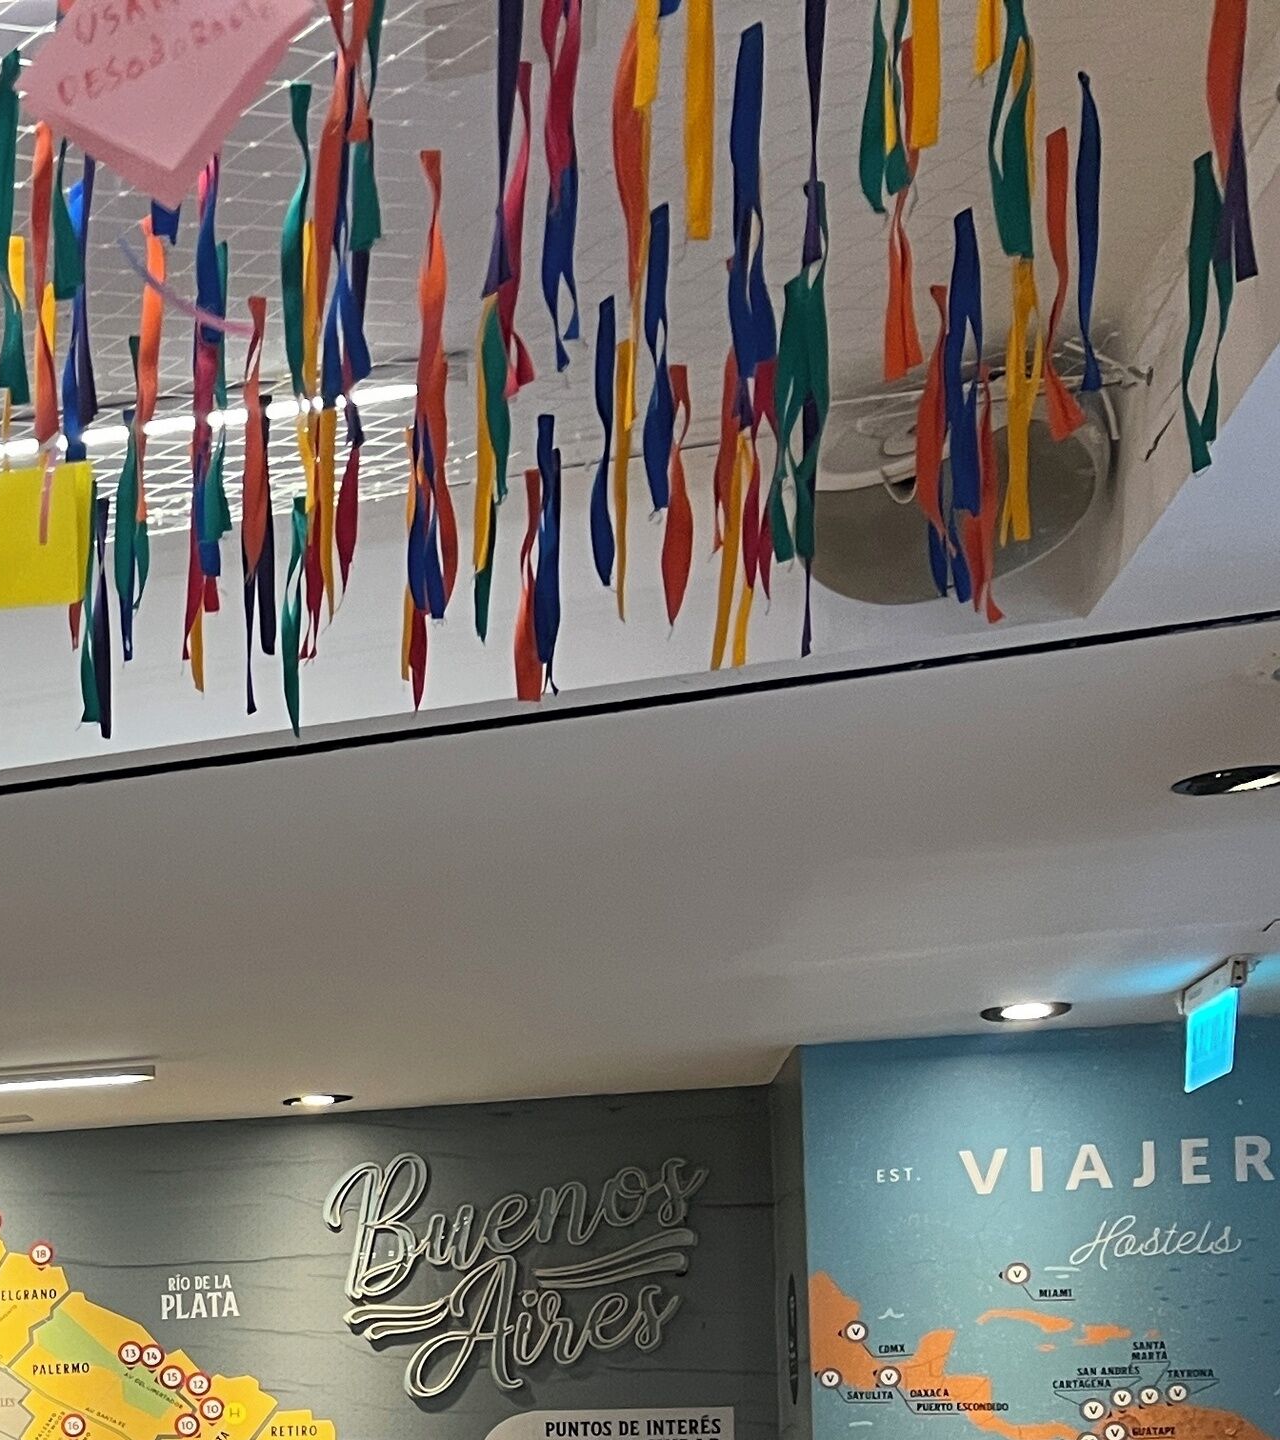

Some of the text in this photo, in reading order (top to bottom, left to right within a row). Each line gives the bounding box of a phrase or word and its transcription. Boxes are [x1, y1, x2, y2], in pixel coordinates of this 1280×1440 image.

[876, 1134, 1276, 1195] EST. VIAJER
[322, 1151, 710, 1300] Buenos
[1070, 1214, 1242, 1271] Hostels
[168, 1273, 232, 1291] RÍO DE LA
[1038, 1288, 1073, 1299] MIAMI
[161, 1291, 240, 1321] PLATA
[404, 1254, 680, 1399] Aires
[878, 1343, 905, 1354] CDMX
[1132, 1341, 1166, 1351] SANTA
[1131, 1351, 1168, 1361] MARTA
[32, 1362, 90, 1375] PALERMO
[1077, 1367, 1097, 1376] SAN
[1167, 1368, 1214, 1378] TAYRONA
[1052, 1378, 1111, 1389] CARTAGENA
[846, 1391, 893, 1400] SAYULITA
[909, 1388, 950, 1398] OAXACA
[916, 1402, 1009, 1412] PUERTO ESCONDIDO
[271, 1425, 317, 1437] RETIRO
[546, 1415, 721, 1437] PUNTOS DE INTERÉS
